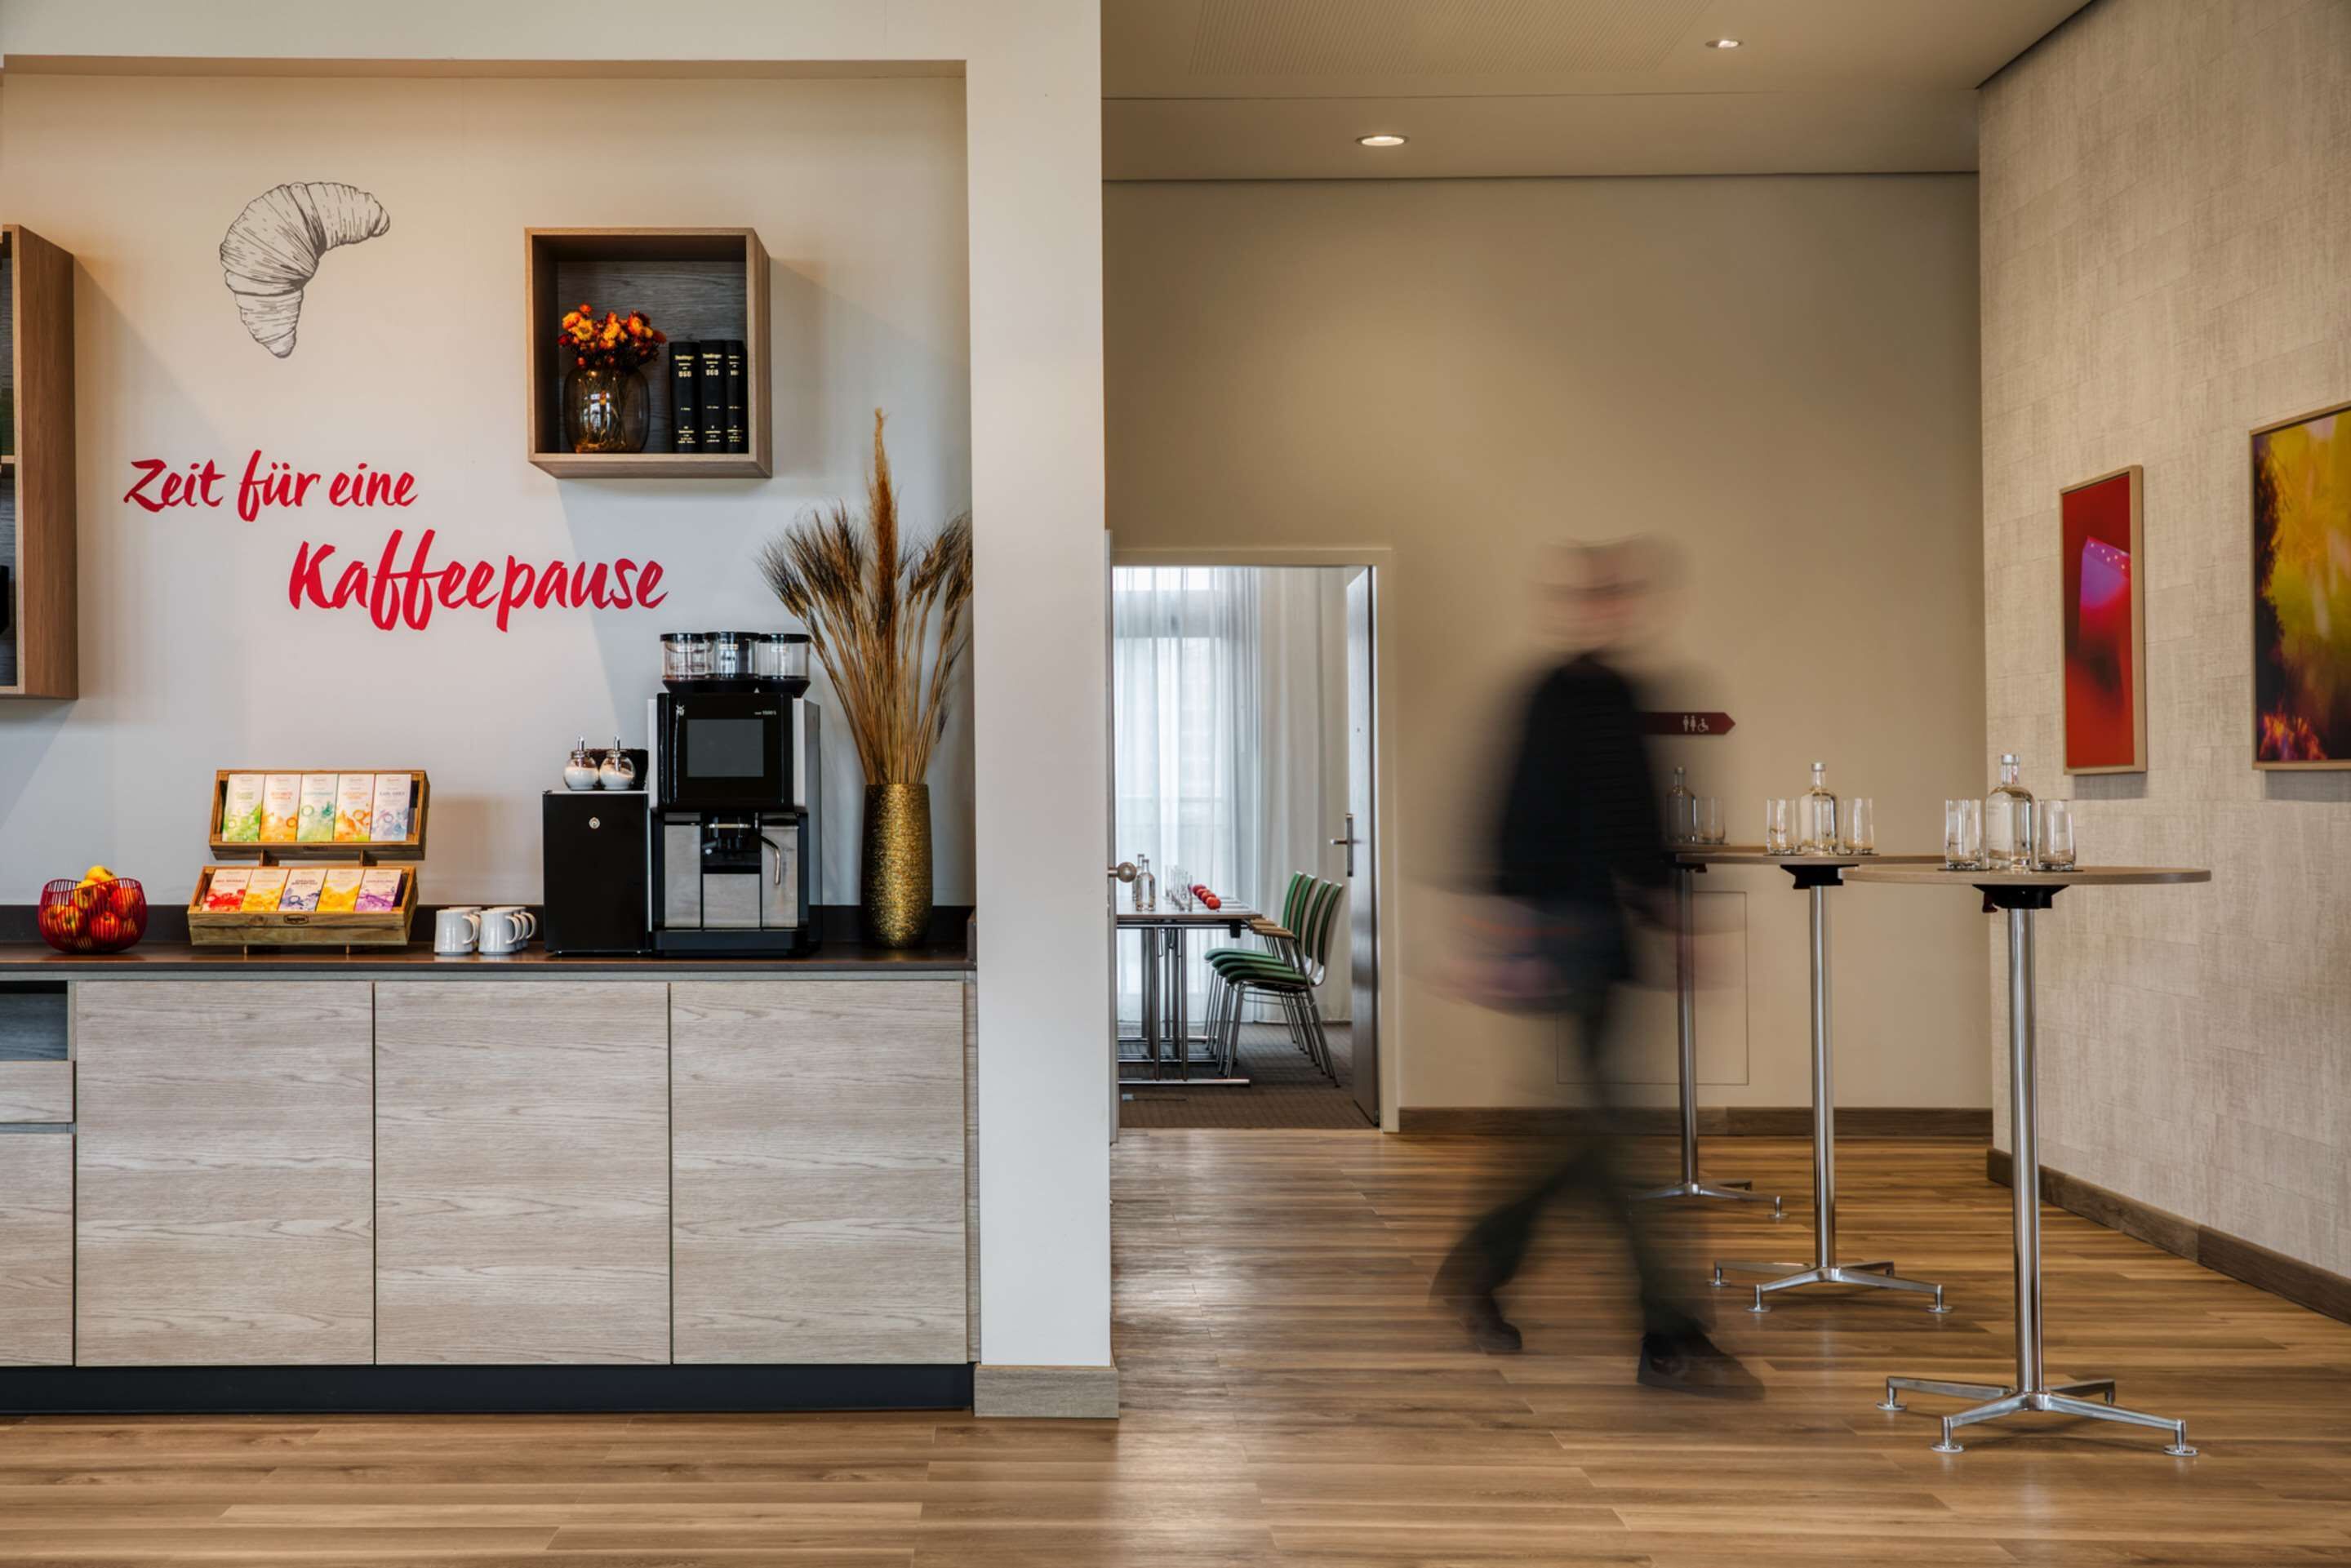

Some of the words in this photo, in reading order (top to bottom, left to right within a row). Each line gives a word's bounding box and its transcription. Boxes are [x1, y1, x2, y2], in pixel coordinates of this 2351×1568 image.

[124, 459, 224, 513] Zeit
[238, 450, 321, 522] für
[329, 463, 418, 508] eine
[289, 529, 669, 633] Kaffeepause
